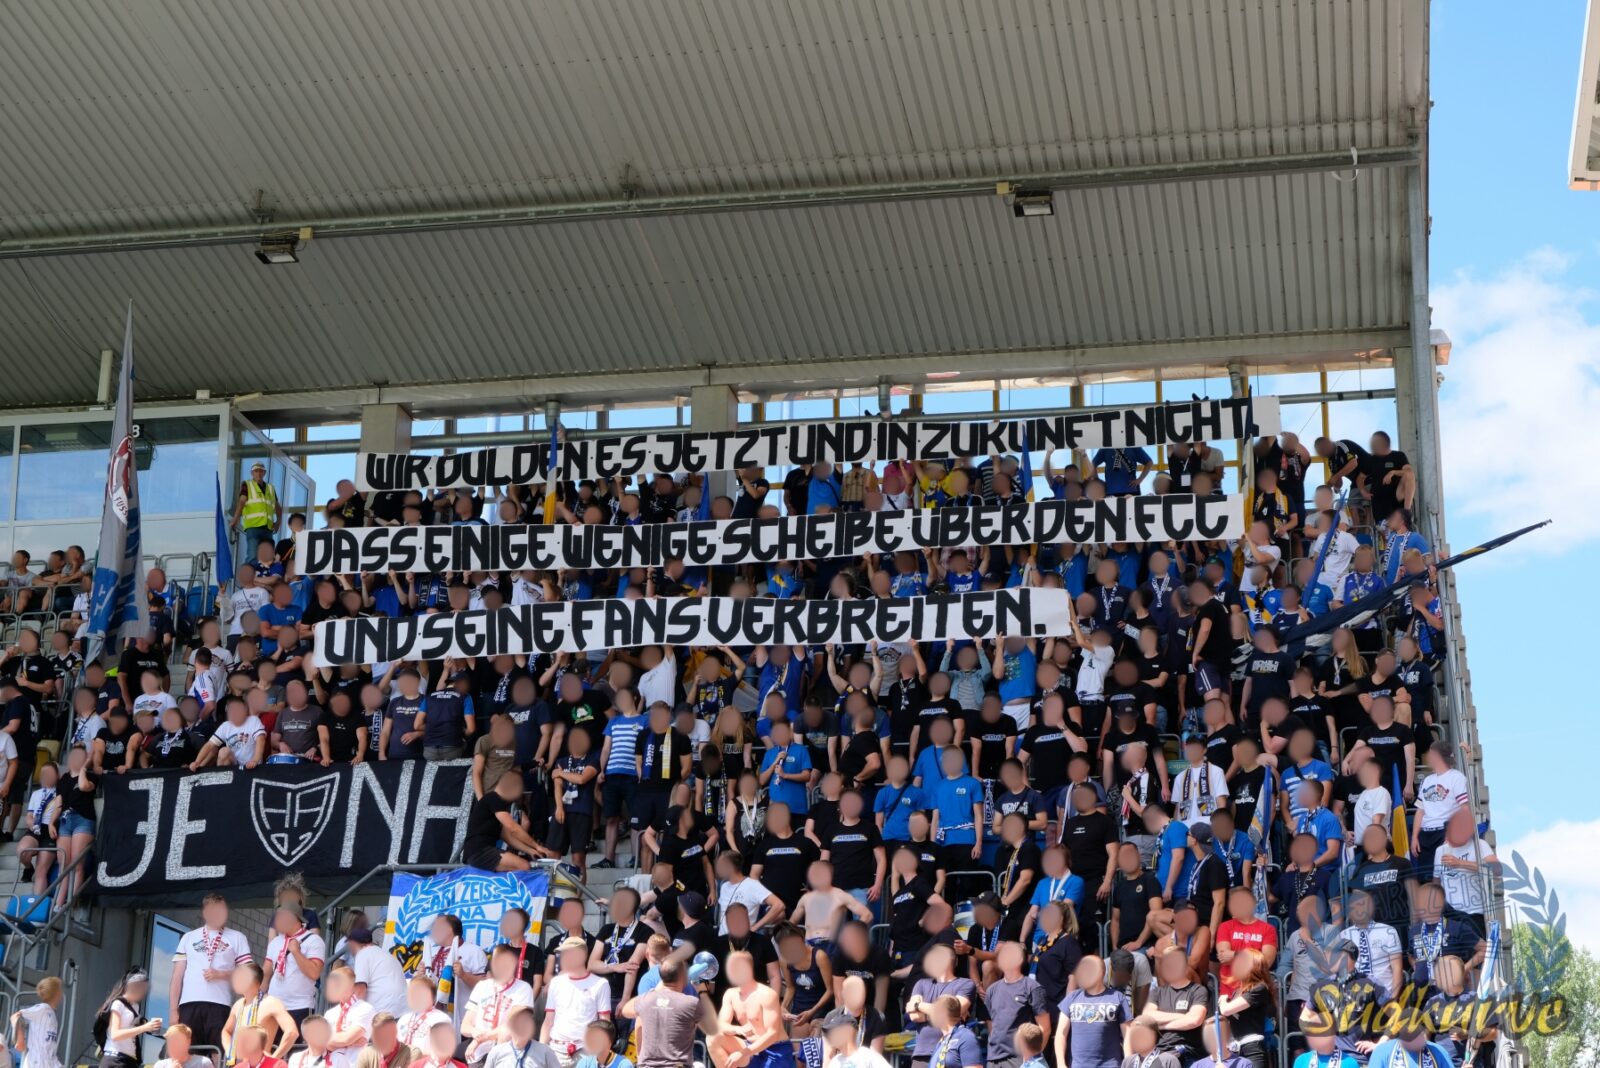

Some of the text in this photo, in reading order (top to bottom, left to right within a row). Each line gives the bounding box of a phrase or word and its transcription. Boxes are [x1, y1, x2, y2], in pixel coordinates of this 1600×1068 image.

[366, 397, 1260, 491] WIR DULDEN ES JETZT UND IN ZUKUNFT NICHT.
[305, 527, 417, 574] DASS
[424, 523, 556, 572] EINIGE
[562, 521, 717, 567] WENIGE
[911, 502, 1030, 547] ÜBER
[1034, 495, 1127, 543] DEN
[1134, 494, 1228, 541] FCC
[324, 588, 1047, 665] UND SEINE FANS VERBREITEN.
